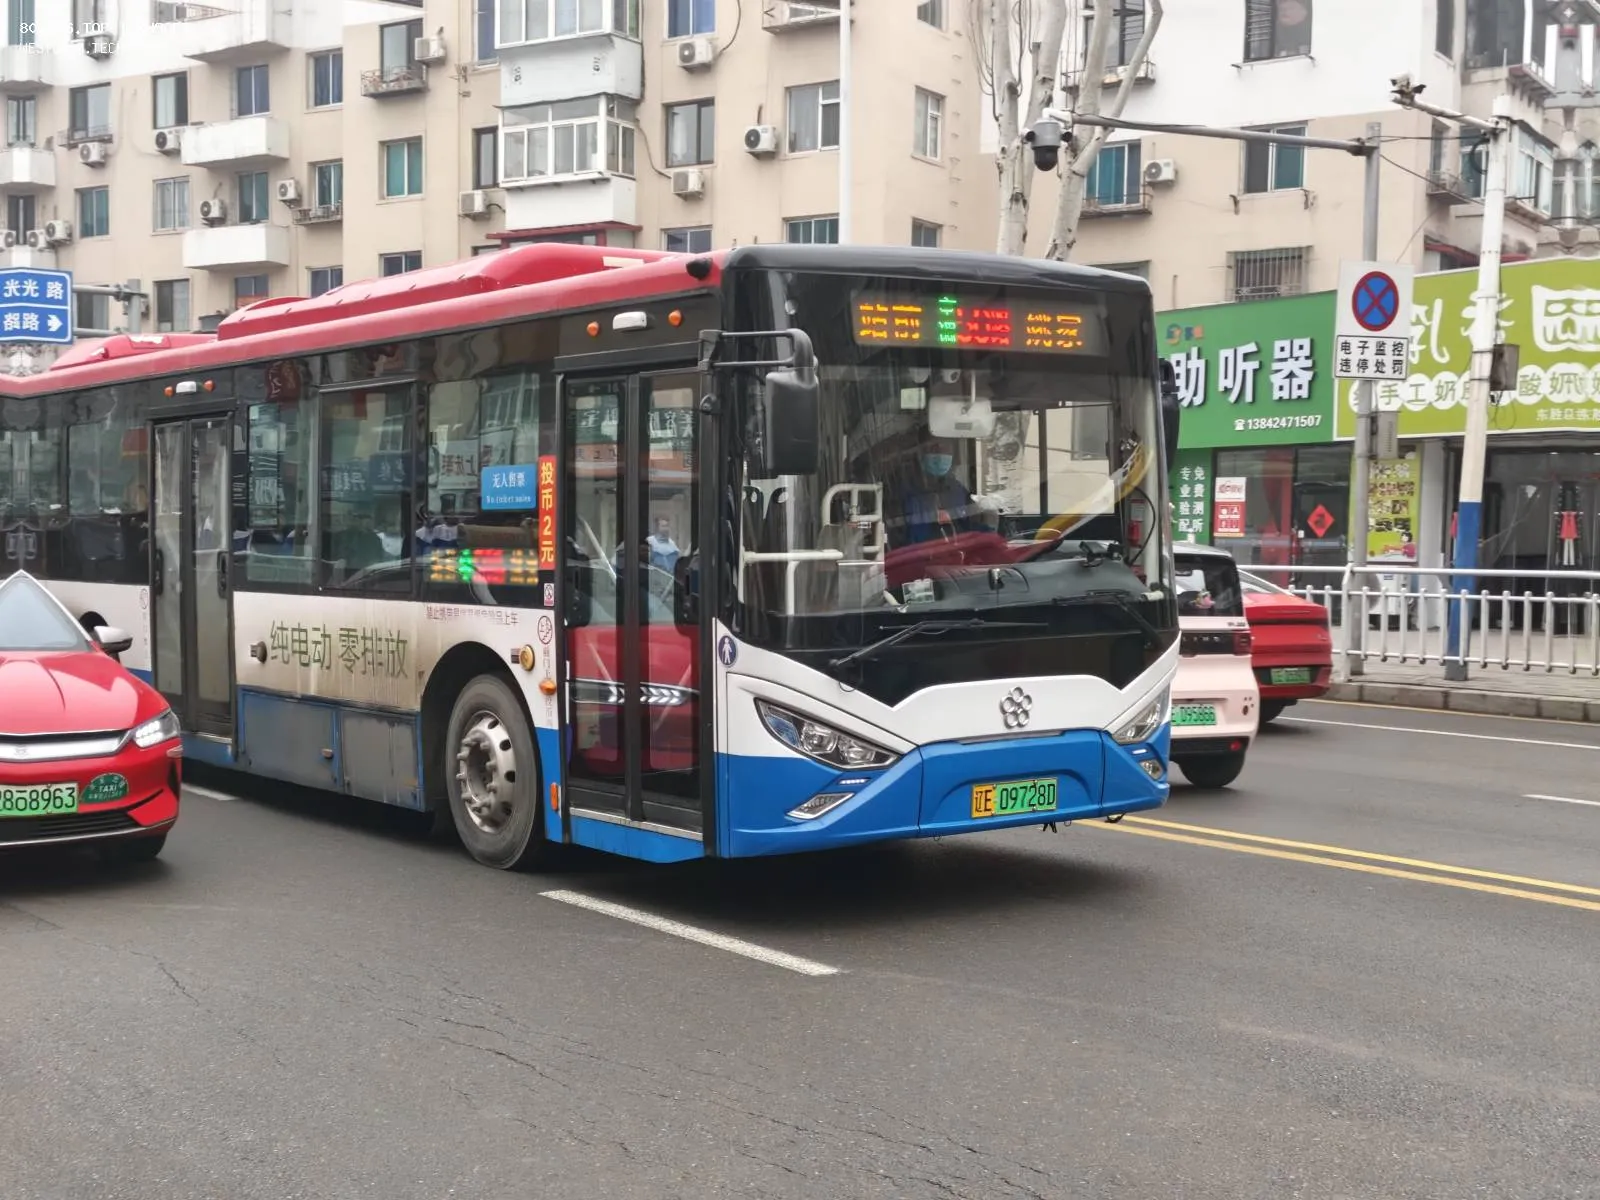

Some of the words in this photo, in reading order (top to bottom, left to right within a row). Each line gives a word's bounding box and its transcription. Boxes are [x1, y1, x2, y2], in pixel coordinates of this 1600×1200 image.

[1340, 340, 1405, 357] 电子监控
[1170, 337, 1315, 408] 助听器
[1339, 357, 1404, 375] 违停处罚
[1248, 415, 1322, 430] 13842471507
[540, 461, 555, 563] 投币2元
[270, 620, 332, 670] 纯电动
[338, 627, 408, 679] 零排放
[99, 784, 118, 793] TAXI
[1000, 783, 1056, 810] 09728D
